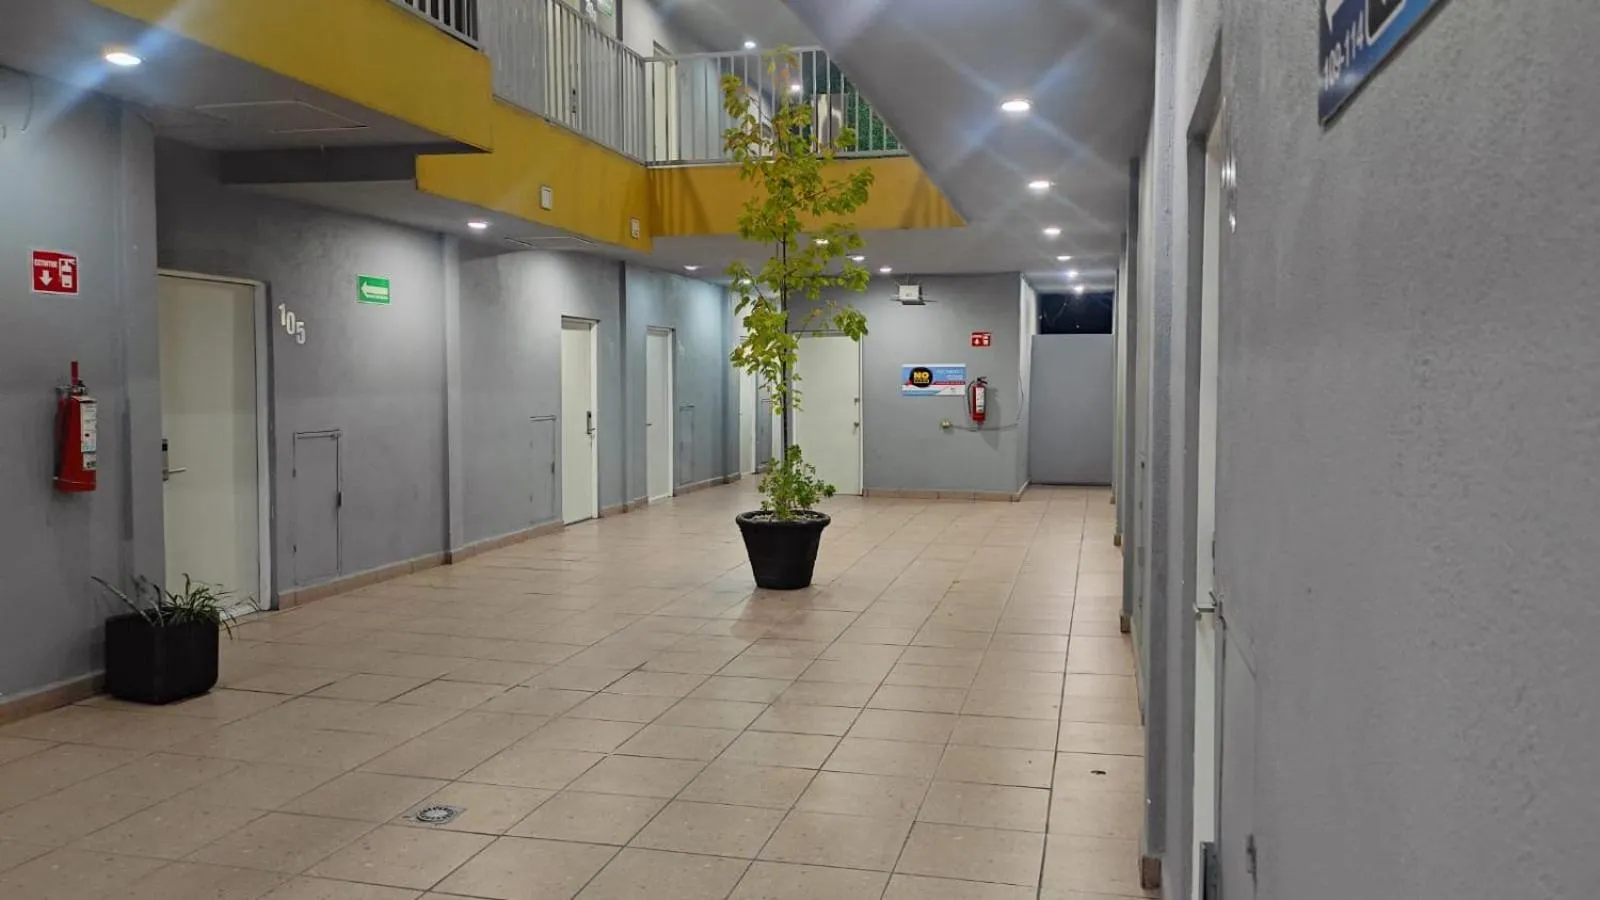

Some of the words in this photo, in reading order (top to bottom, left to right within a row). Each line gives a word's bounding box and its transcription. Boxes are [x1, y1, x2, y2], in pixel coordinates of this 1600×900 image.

[1324, 10, 1364, 91] 109-114
[278, 303, 305, 345] 105
[913, 371, 930, 380] NO
